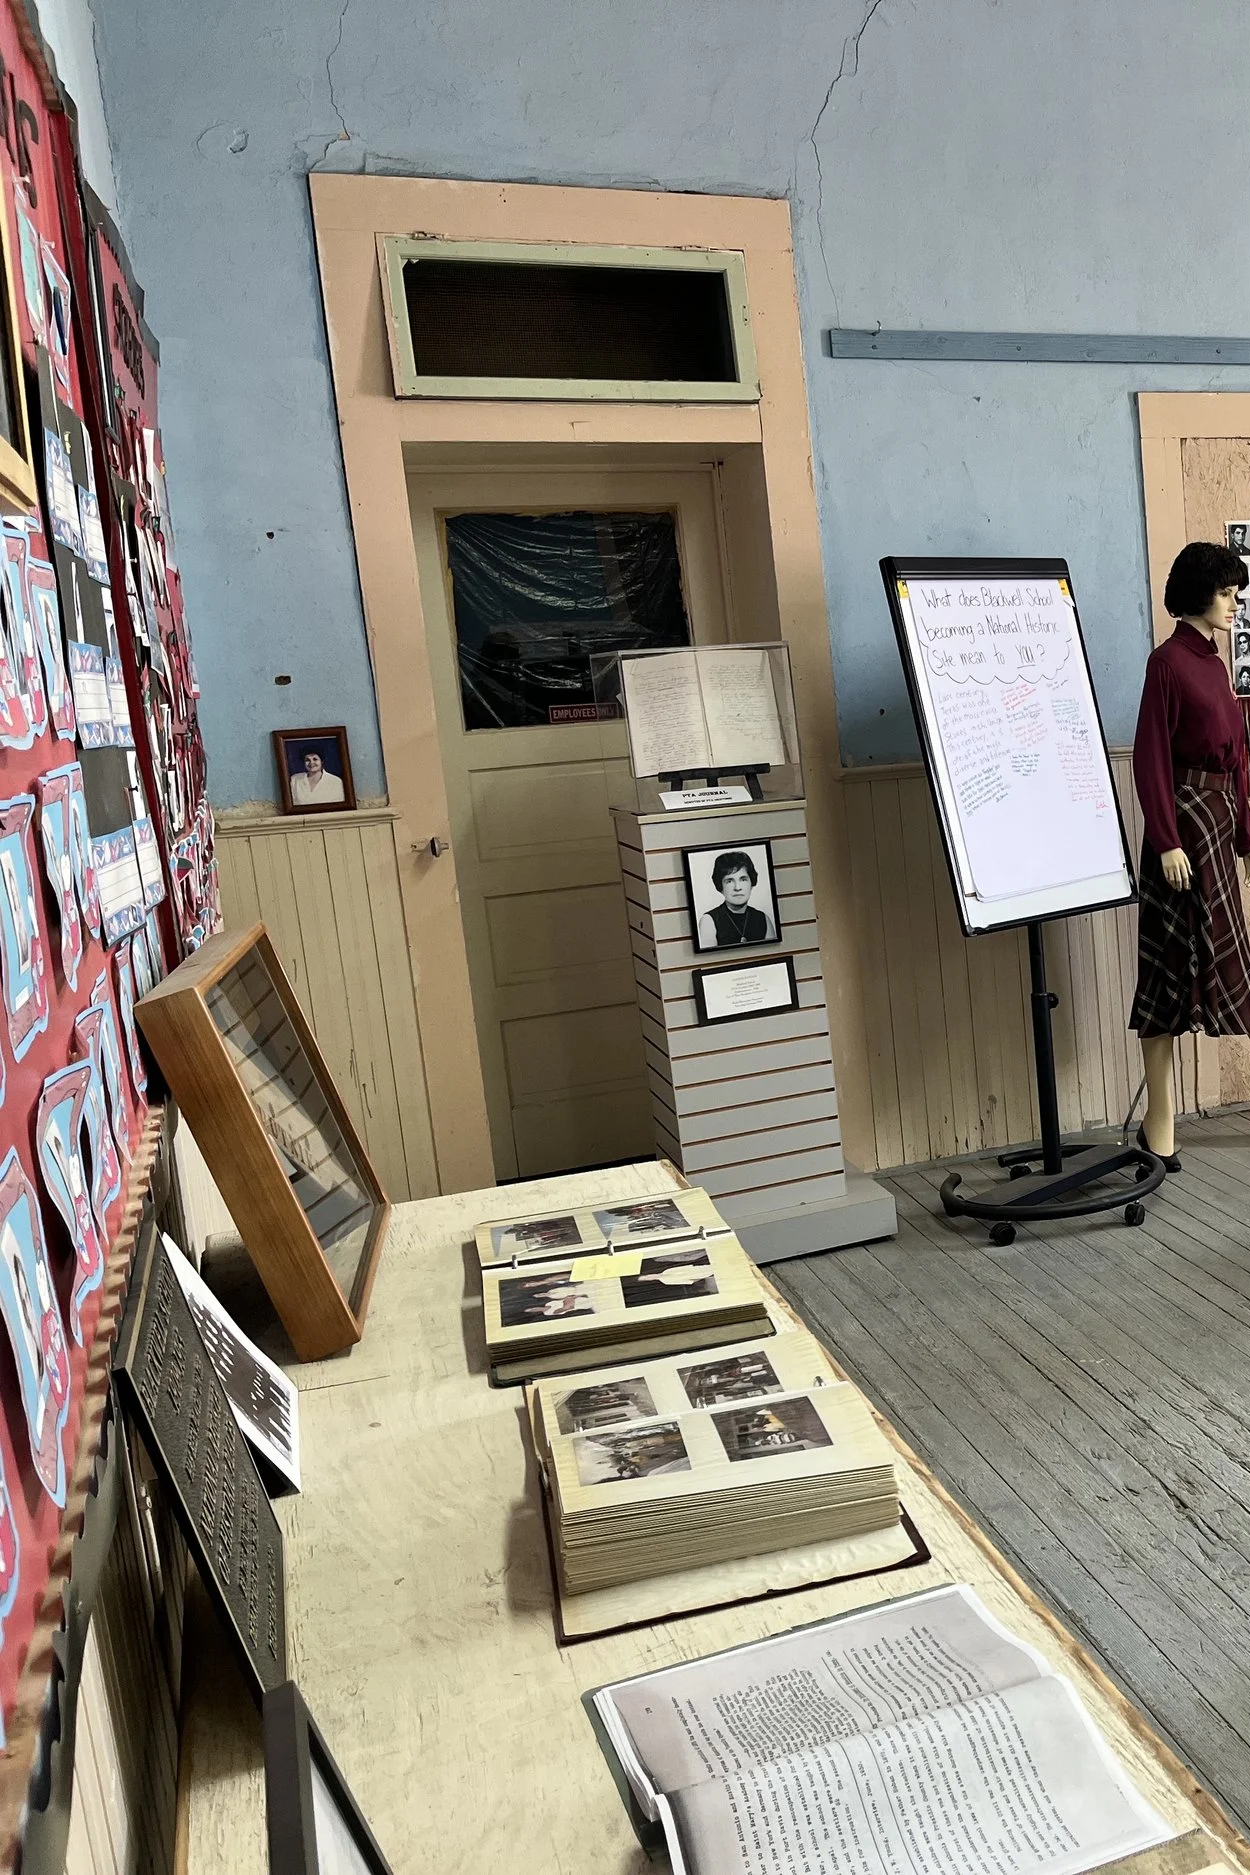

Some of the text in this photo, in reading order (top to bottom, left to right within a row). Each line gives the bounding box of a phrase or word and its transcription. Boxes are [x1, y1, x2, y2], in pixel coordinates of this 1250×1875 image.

[921, 587, 1053, 608] What does Blackwell School
[920, 612, 1060, 644] becoming a National Historic
[932, 650, 956, 669] Site
[960, 651, 987, 667] mean
[993, 643, 1005, 665] to
[552, 708, 596, 719] EMPLOYEES
[140, 1304, 167, 1423] BLACKWELL
[200, 1441, 218, 1547] NATIONAL
[219, 1459, 233, 1560] HISTORIC
[218, 1541, 230, 1583] OF
[917, 1745, 935, 1782] established
[791, 1774, 809, 1811] established
[810, 1789, 819, 1801] was
[824, 1788, 834, 1805] were
[862, 1777, 874, 1797] June,
[916, 1780, 930, 1802] County
[769, 1789, 781, 1813] during
[893, 1794, 907, 1818] Father
[908, 1794, 917, 1806] the
[744, 1804, 757, 1828] Mary's
[761, 1814, 770, 1827] and
[775, 1814, 786, 1834] Davis
[804, 1813, 813, 1826] was
[814, 1802, 826, 1825] school
[829, 1805, 843, 1836] settlers
[842, 1802, 860, 1846] instruction.
[869, 1799, 886, 1835] Interview,
[902, 1818, 911, 1827] by
[924, 1803, 940, 1832] Presidio
[729, 1801, 751, 1868] to San Antonio and
[751, 1830, 762, 1849] Saint
[765, 1828, 775, 1845] York
[793, 1827, 802, 1840] the
[807, 1827, 820, 1851] school
[821, 1826, 831, 1840] The
[838, 1837, 847, 1850] the
[770, 1846, 779, 1860] New
[780, 1835, 791, 1853] Fort
[797, 1841, 807, 1859] with
[905, 1827, 925, 1863] established
[756, 1851, 764, 1860] to
[773, 1861, 782, 1871] to
[785, 1853, 793, 1863] in
[827, 1845, 841, 1871] chapel.
[843, 1851, 852, 1863] and
